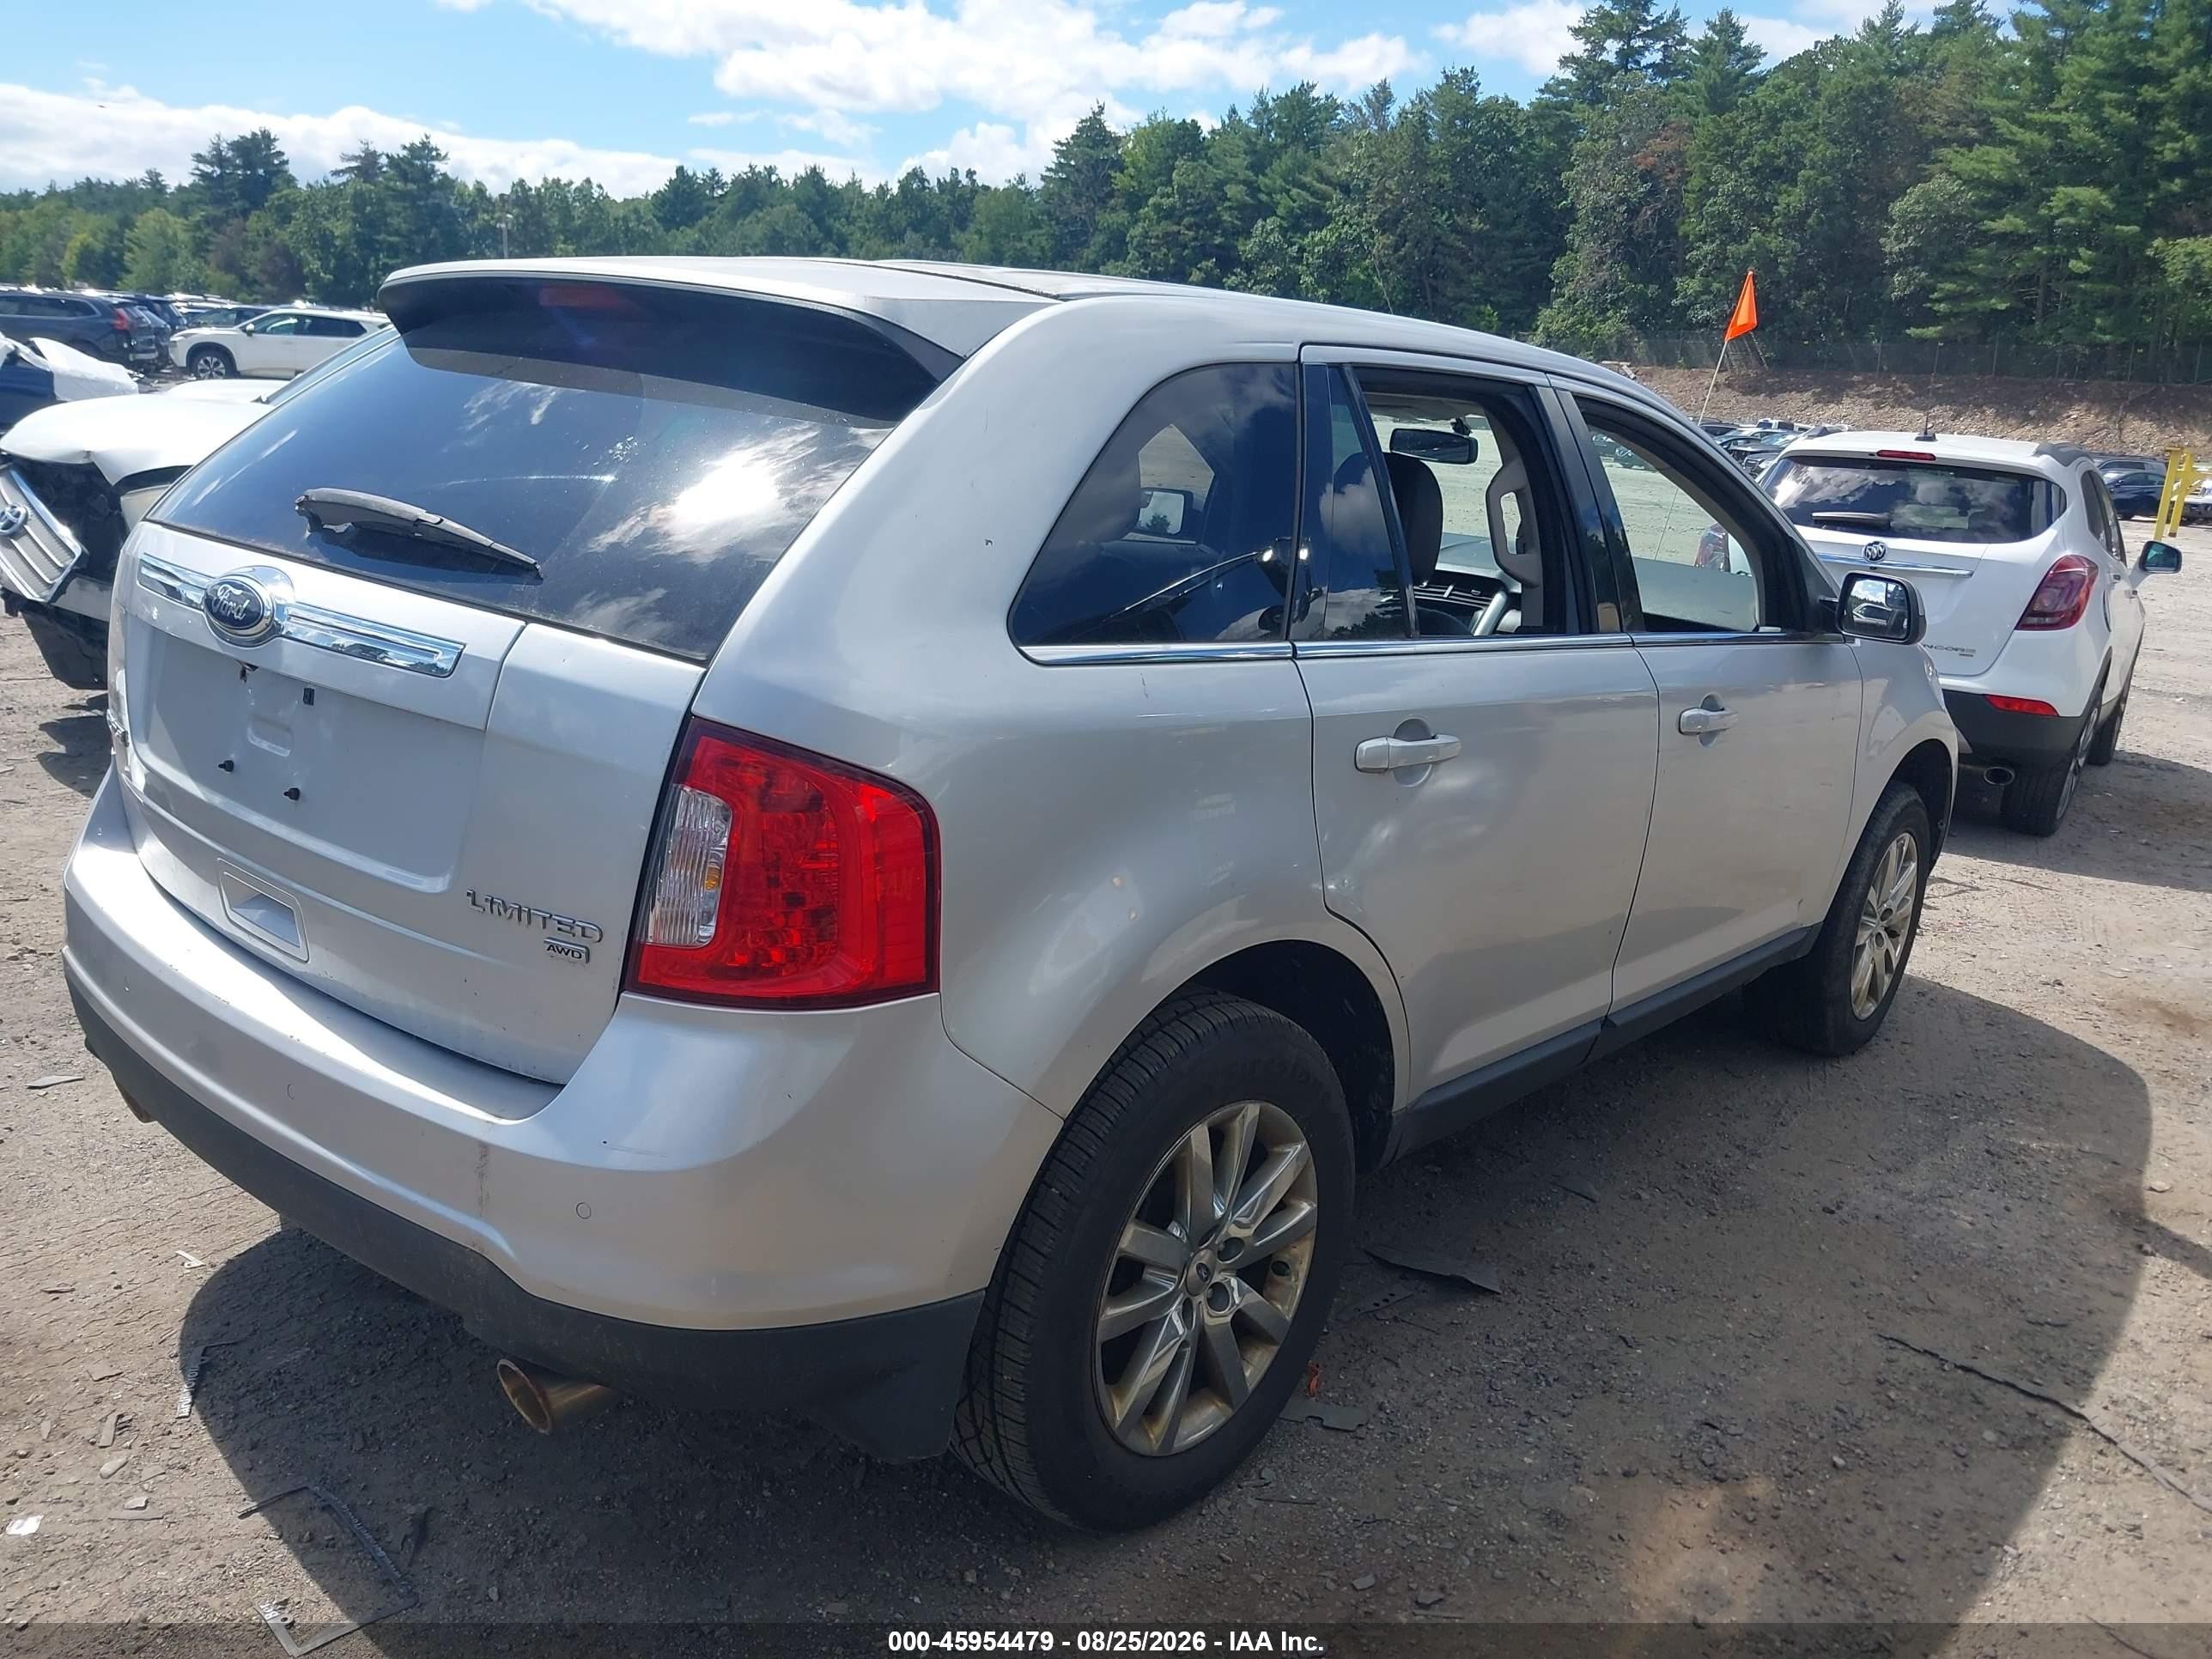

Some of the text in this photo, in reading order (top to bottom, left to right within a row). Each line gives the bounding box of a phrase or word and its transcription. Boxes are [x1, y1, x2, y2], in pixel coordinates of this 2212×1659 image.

[211, 583, 251, 621] Ford
[1923, 644, 1977, 653] NCOR
[466, 888, 604, 944] LIMITED
[545, 943, 583, 960] AWD
